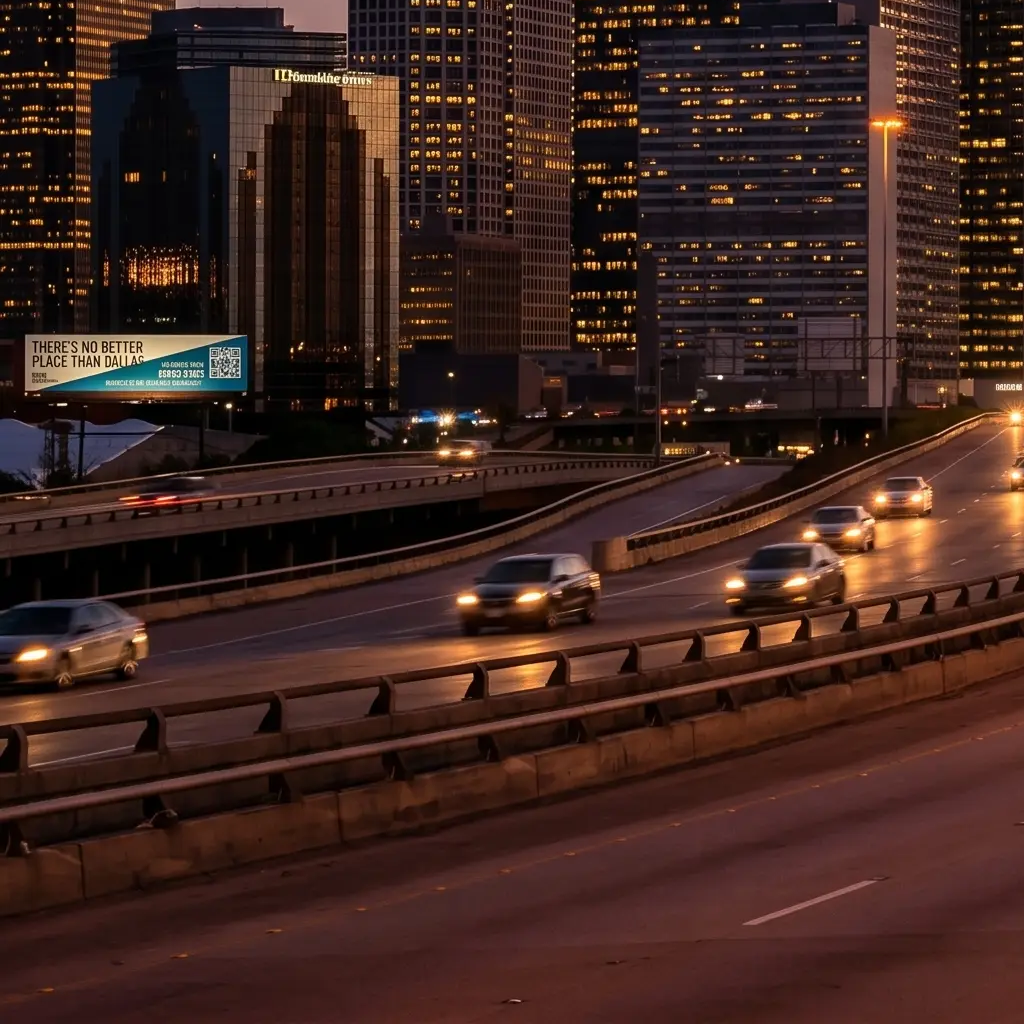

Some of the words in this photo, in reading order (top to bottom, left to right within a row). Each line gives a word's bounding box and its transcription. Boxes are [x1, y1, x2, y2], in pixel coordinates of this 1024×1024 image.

[32, 340, 78, 354] THERE'S
[82, 340, 98, 354] NO
[101, 340, 144, 354] BETTER
[32, 355, 68, 368] PLACE
[72, 355, 101, 368] THAN
